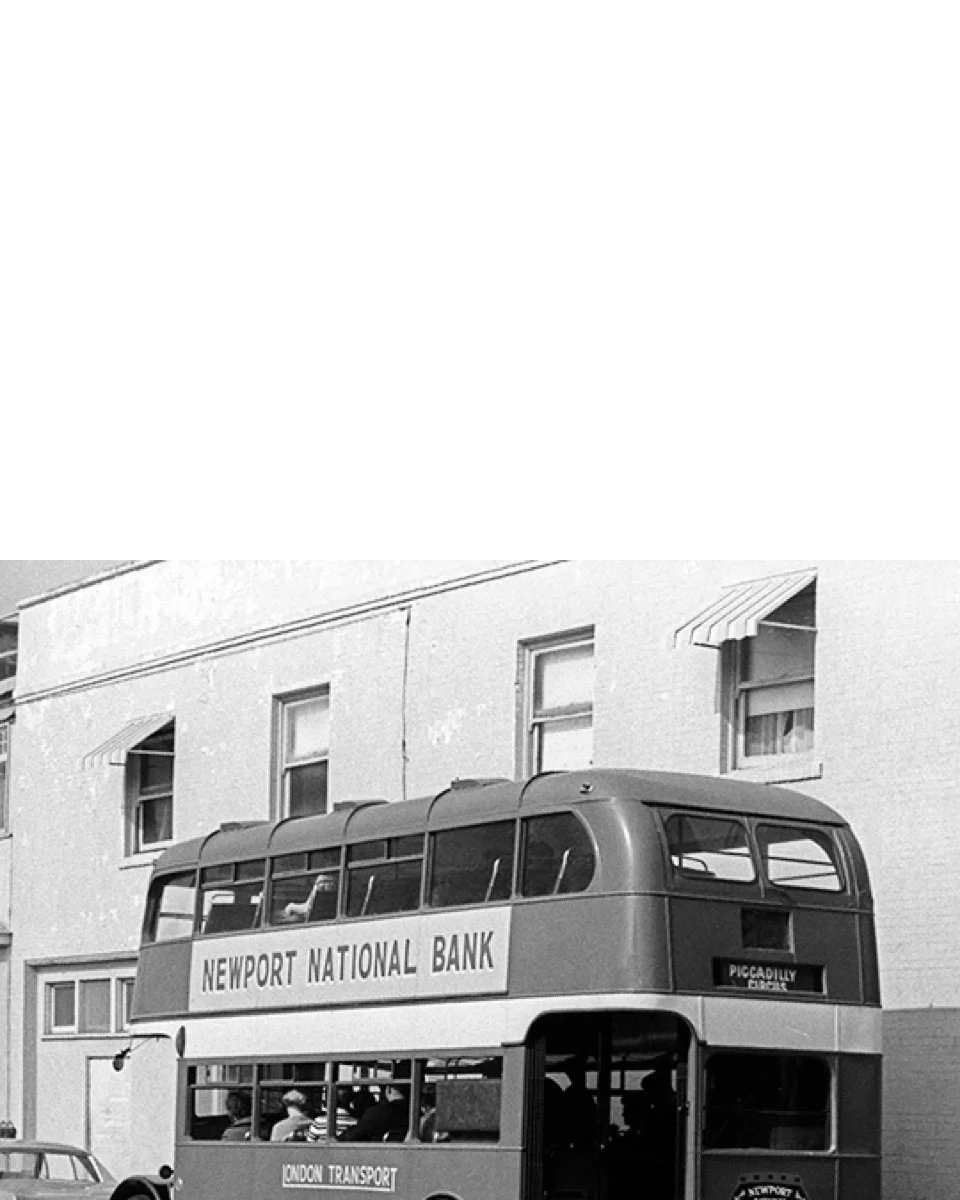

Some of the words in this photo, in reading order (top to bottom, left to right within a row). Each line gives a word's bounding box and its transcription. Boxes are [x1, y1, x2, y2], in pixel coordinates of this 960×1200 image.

[202, 950, 298, 993] NEWPORT
[307, 938, 417, 984] NATIONAL
[431, 930, 494, 973] BANK
[728, 964, 798, 982] PICCADILLY
[747, 979, 789, 993] CIRCUS
[282, 1163, 323, 1188] LONDON
[328, 1164, 398, 1192] TRANSPORT
[747, 1184, 793, 1197] NEWPORT
